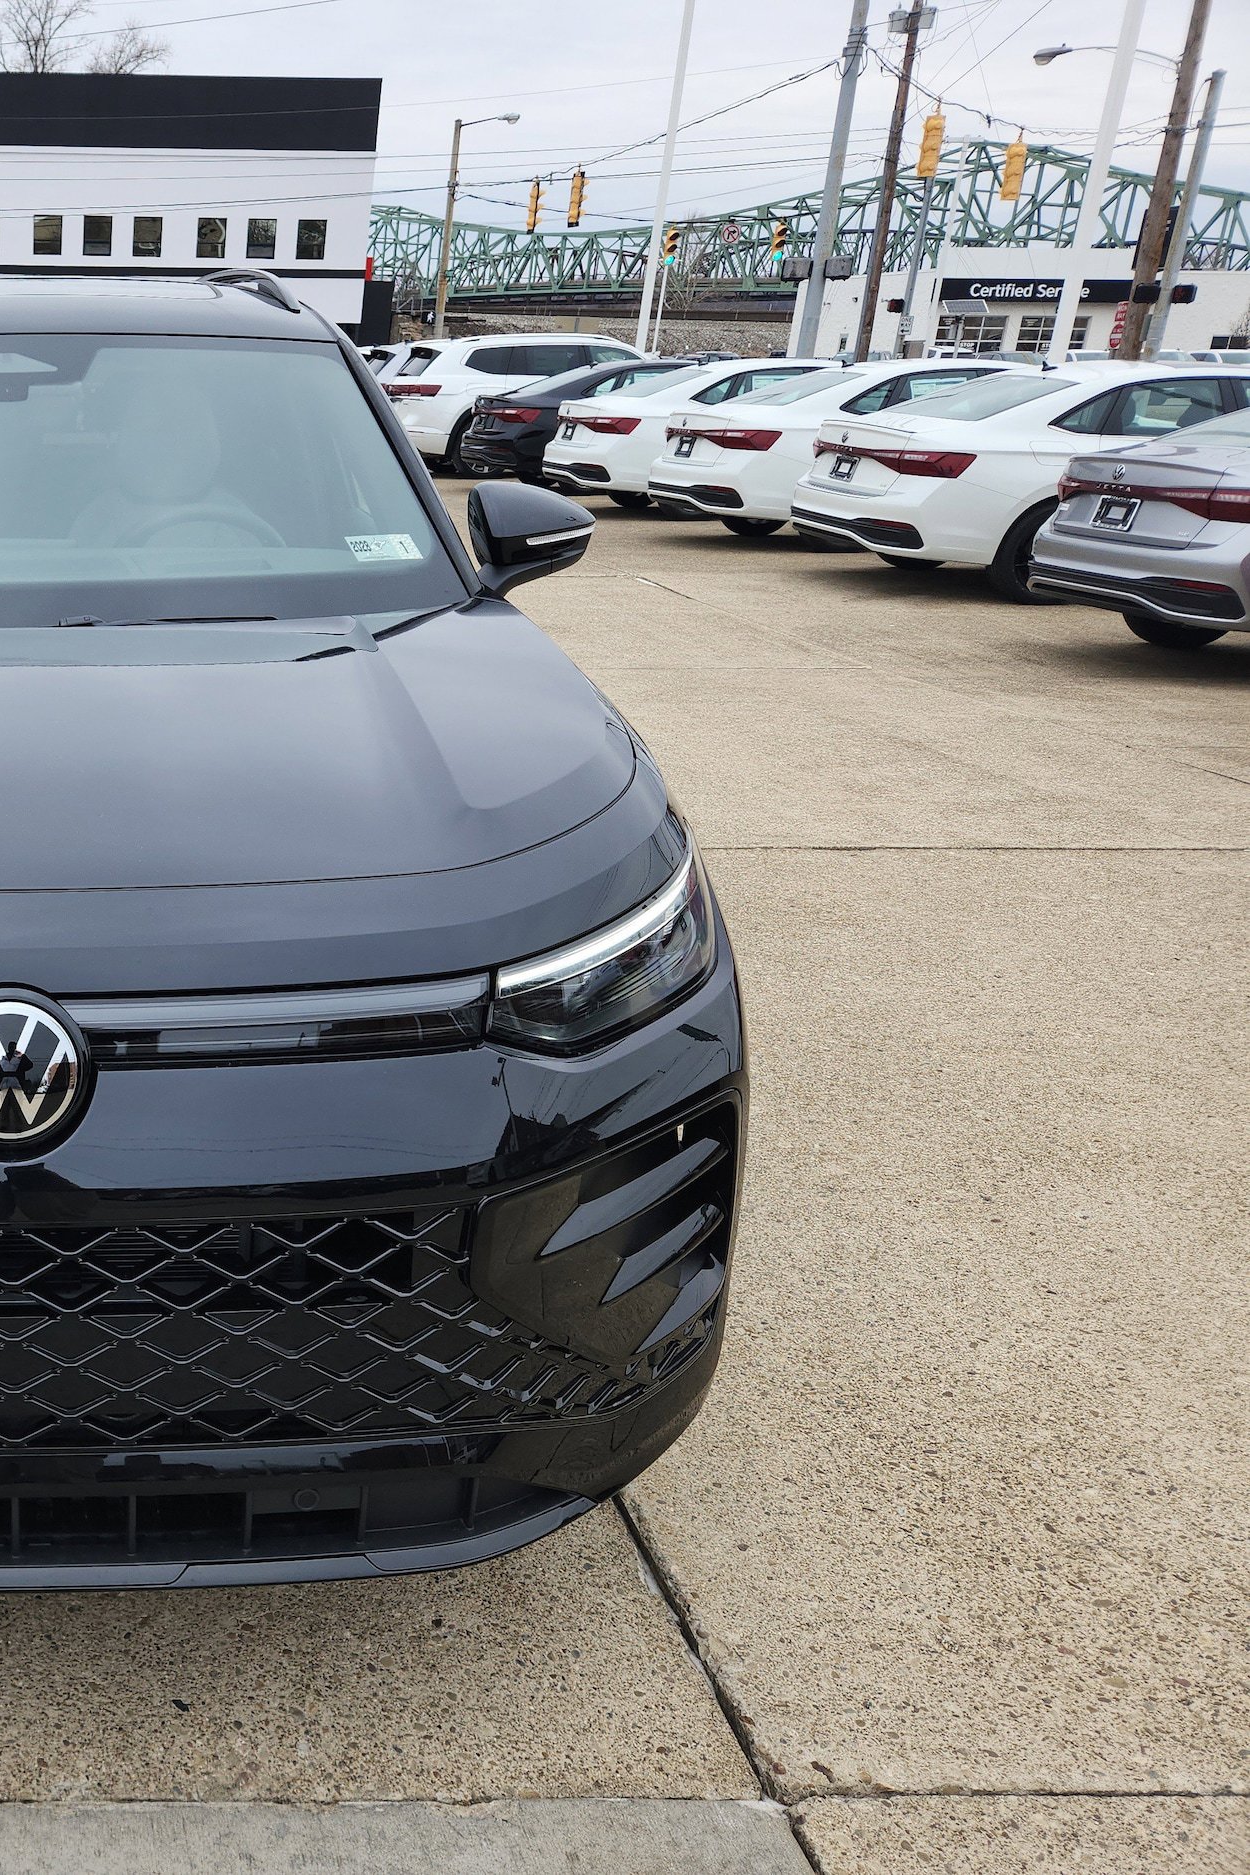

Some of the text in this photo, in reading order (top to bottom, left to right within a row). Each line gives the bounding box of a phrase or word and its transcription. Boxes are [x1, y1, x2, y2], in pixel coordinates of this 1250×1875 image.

[969, 282, 1091, 299] Certified Sere
[1096, 484, 1132, 493] JETTA
